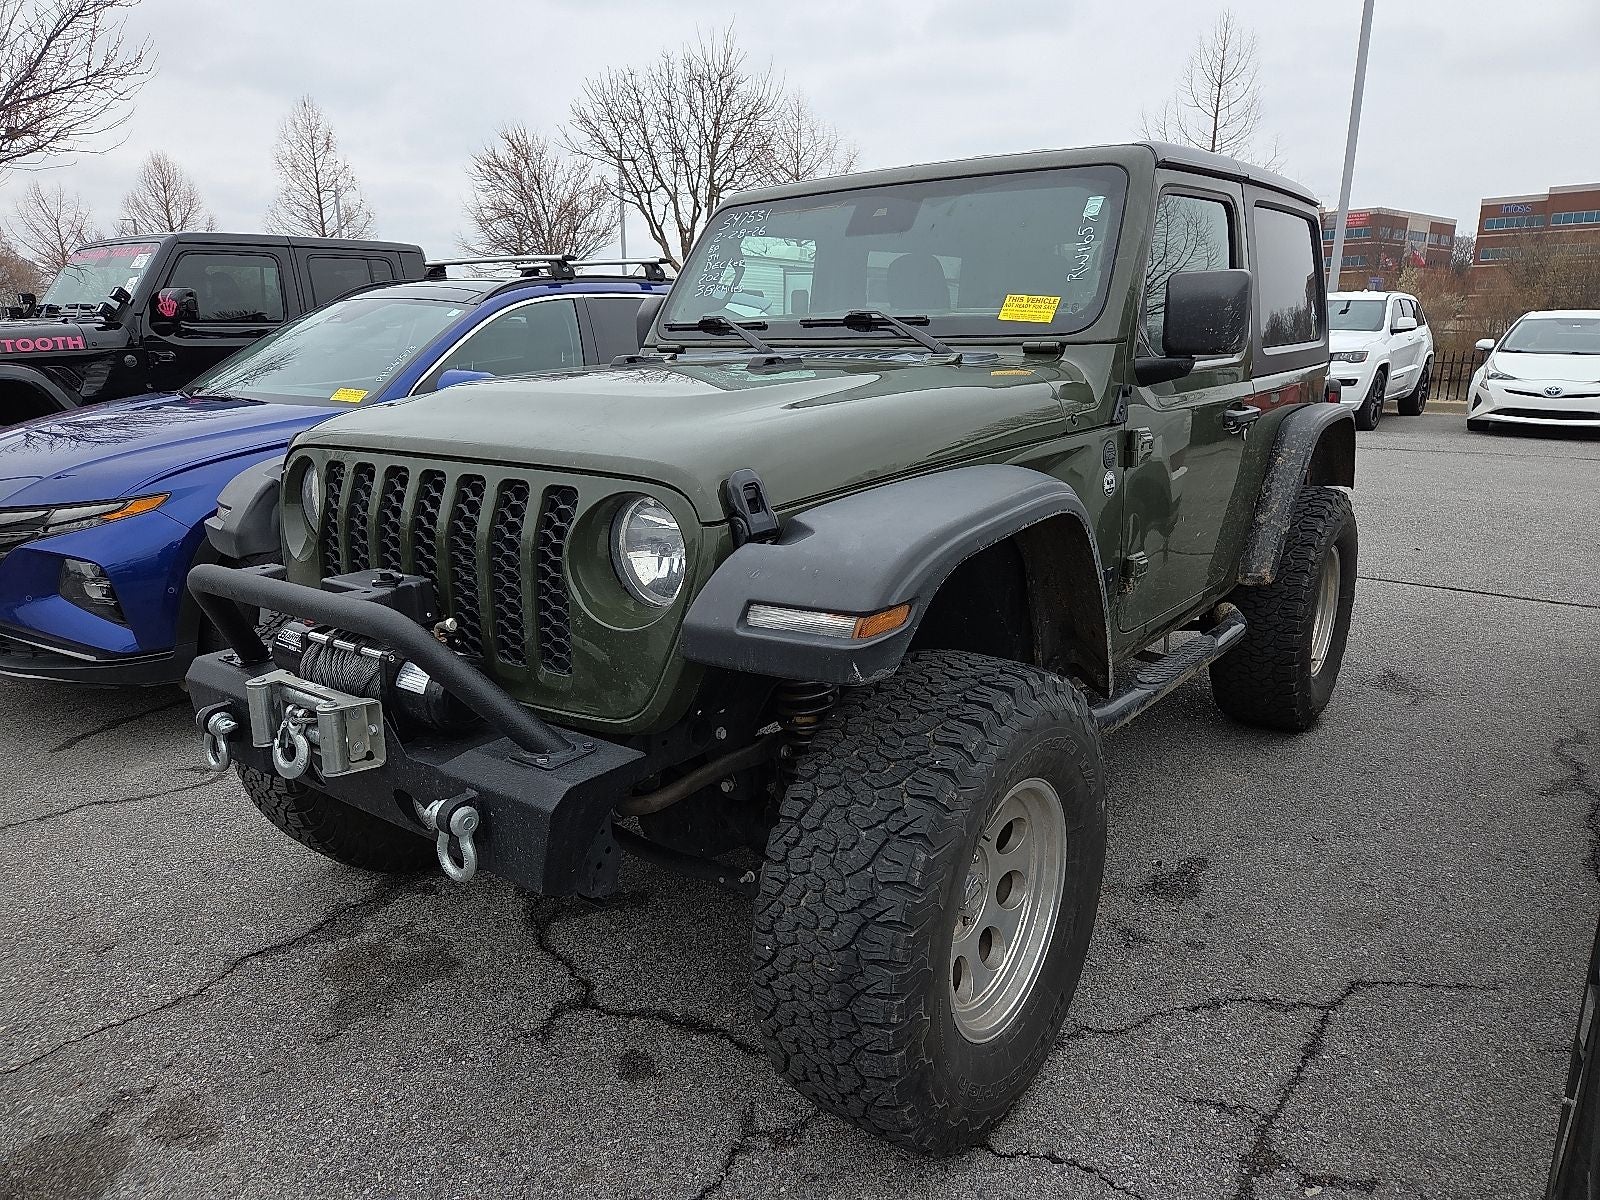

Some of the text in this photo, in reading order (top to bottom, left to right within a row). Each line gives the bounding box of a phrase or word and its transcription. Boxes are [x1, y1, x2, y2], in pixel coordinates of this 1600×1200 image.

[1502, 204, 1532, 214] Infosys
[714, 226, 766, 242] 2-28-26
[1027, 297, 1059, 305] VEHICLE
[0, 336, 85, 353] TOOTH
